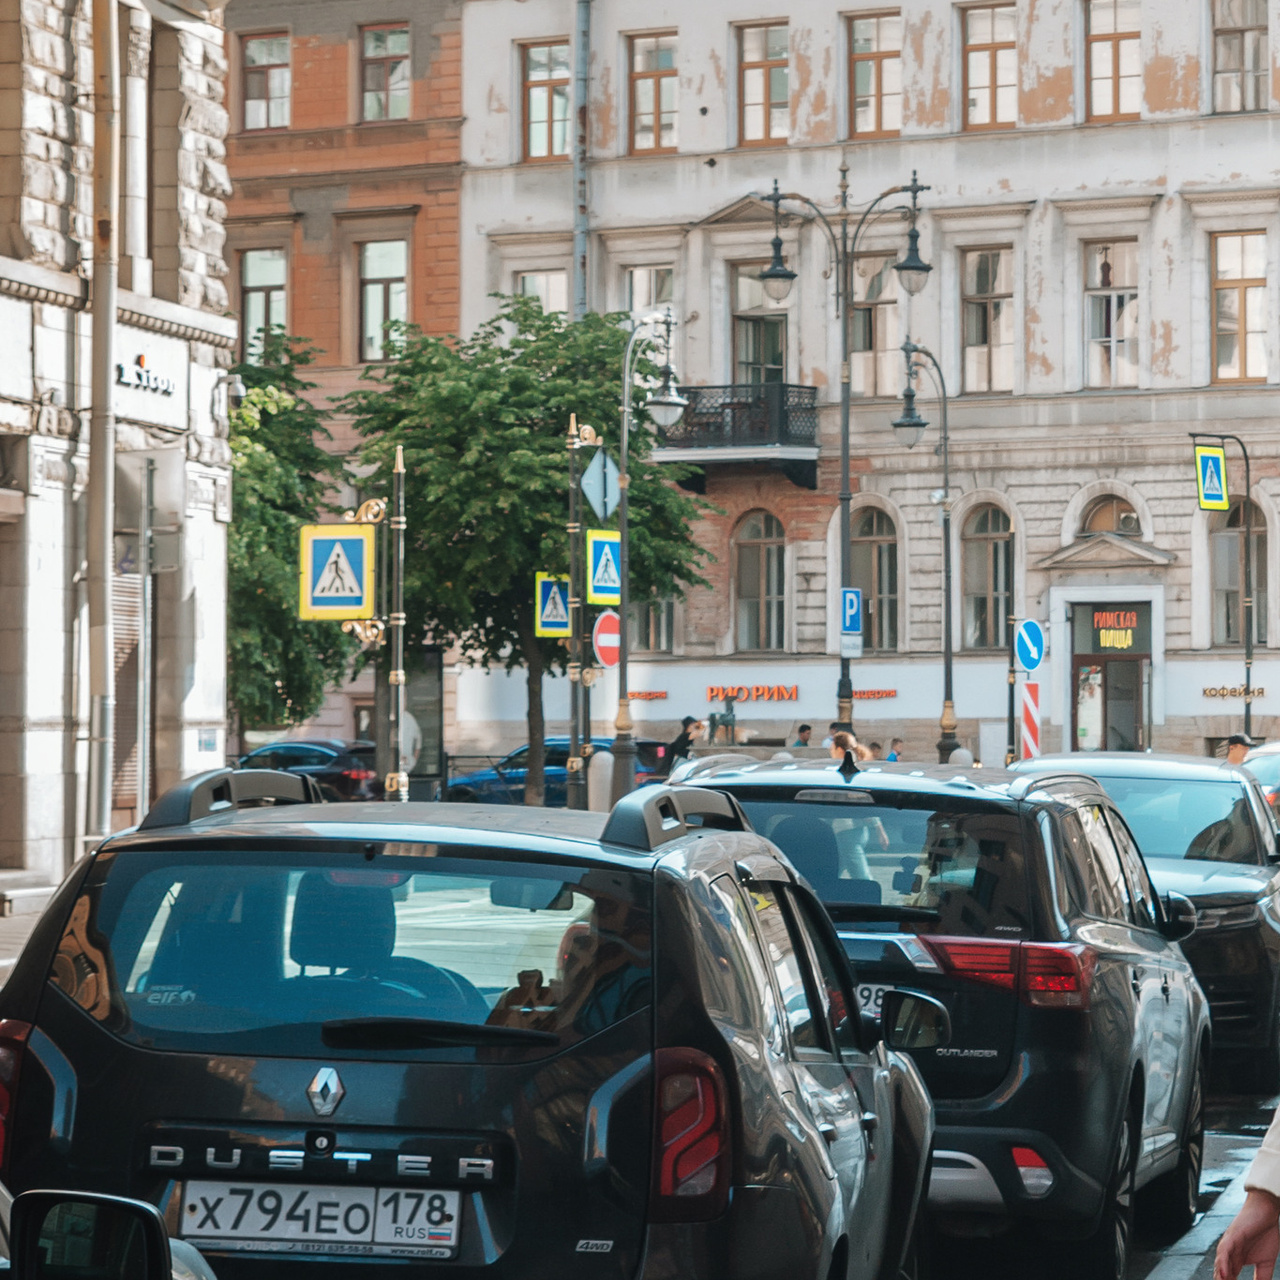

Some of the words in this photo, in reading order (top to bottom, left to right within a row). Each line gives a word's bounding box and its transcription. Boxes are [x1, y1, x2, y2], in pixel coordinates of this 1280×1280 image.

[845, 592, 858, 627] P
[1093, 611, 1138, 629] РИМСКАЯ
[1099, 629, 1133, 649] ПИЦЦА
[627, 691, 667, 700] екарня
[706, 686, 749, 702] РИО
[752, 685, 798, 701] РИМ
[1202, 684, 1265, 699] кофейня
[147, 991, 179, 1004] elf
[936, 1048, 998, 1058] OUTLANDER
[150, 1145, 494, 1180] DUSTER
[382, 1191, 448, 1227] 178
[393, 1226, 427, 1239] RUS
[578, 1241, 611, 1251] 4WD
